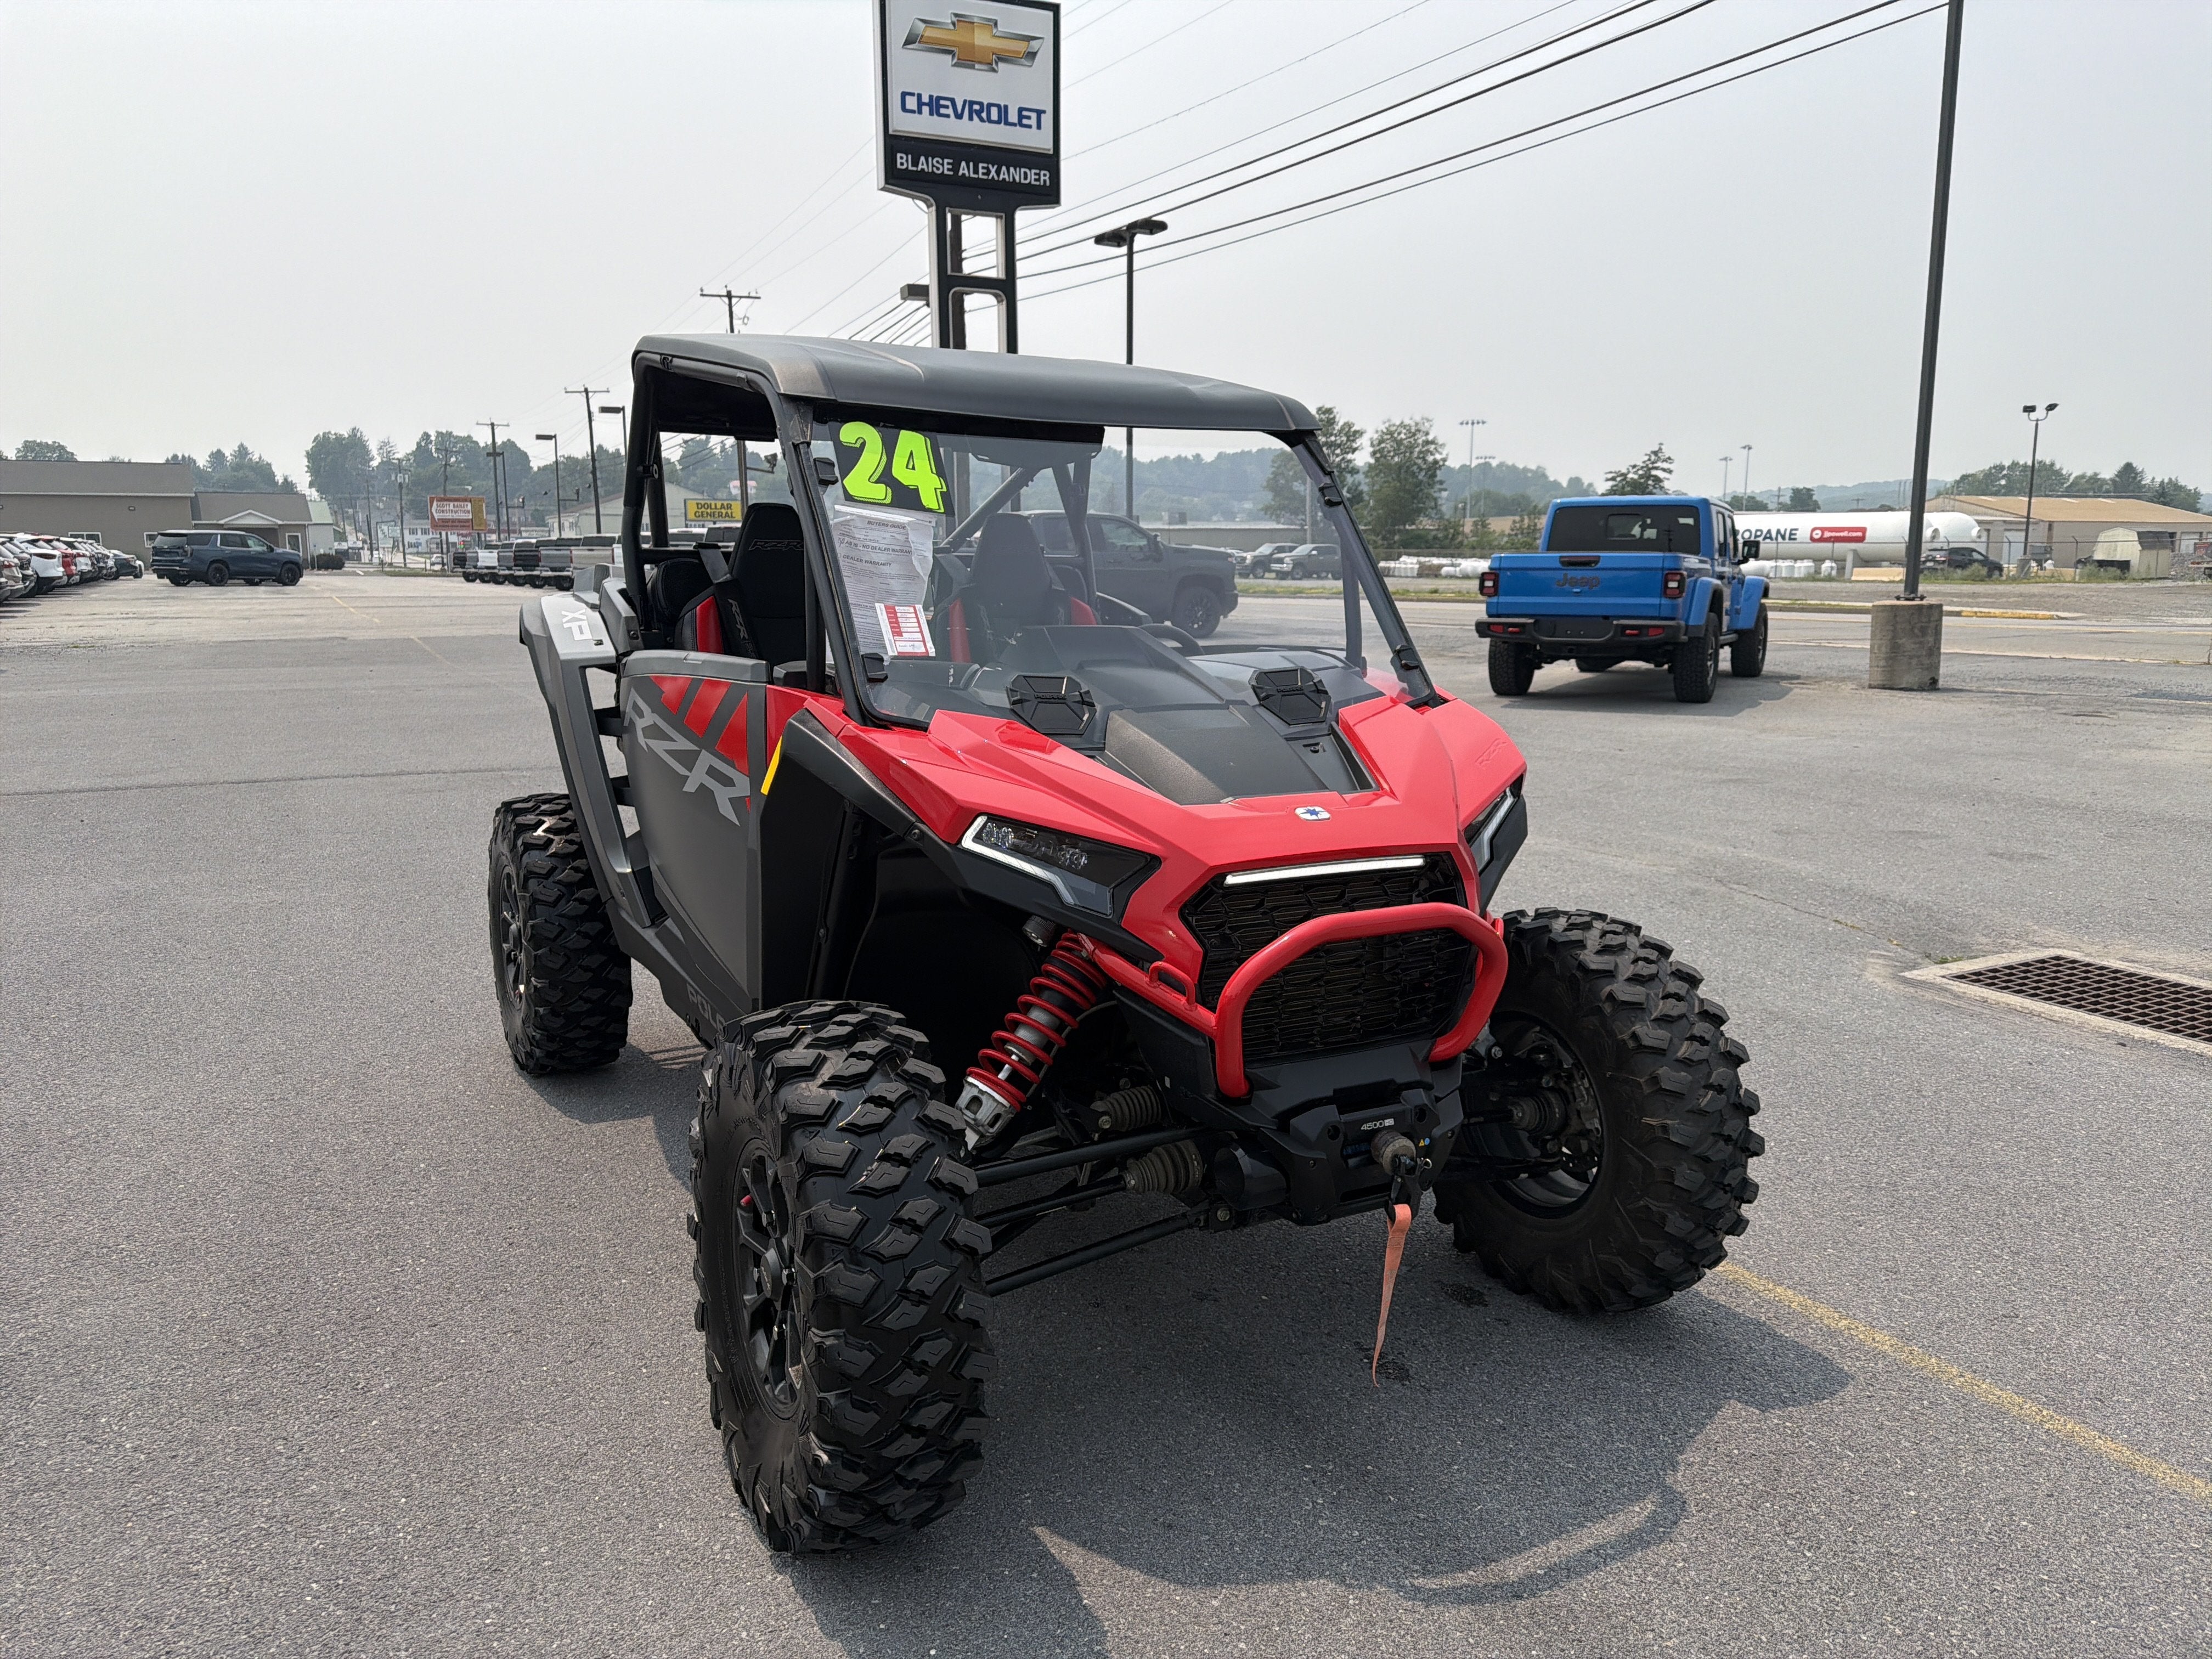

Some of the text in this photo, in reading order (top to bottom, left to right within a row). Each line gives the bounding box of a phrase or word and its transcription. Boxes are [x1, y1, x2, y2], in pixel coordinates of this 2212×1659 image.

[900, 91, 1046, 130] CHEVROLET
[896, 153, 1050, 187] BLAISE ALEXANDER
[839, 421, 947, 512] 24
[696, 502, 732, 510] DOLLAR
[843, 554, 891, 567] DEALER WARRANTY
[1556, 573, 1600, 590] Jeep
[562, 608, 592, 640] XP
[623, 687, 750, 827] RZR
[1361, 1120, 1384, 1130] 4500
